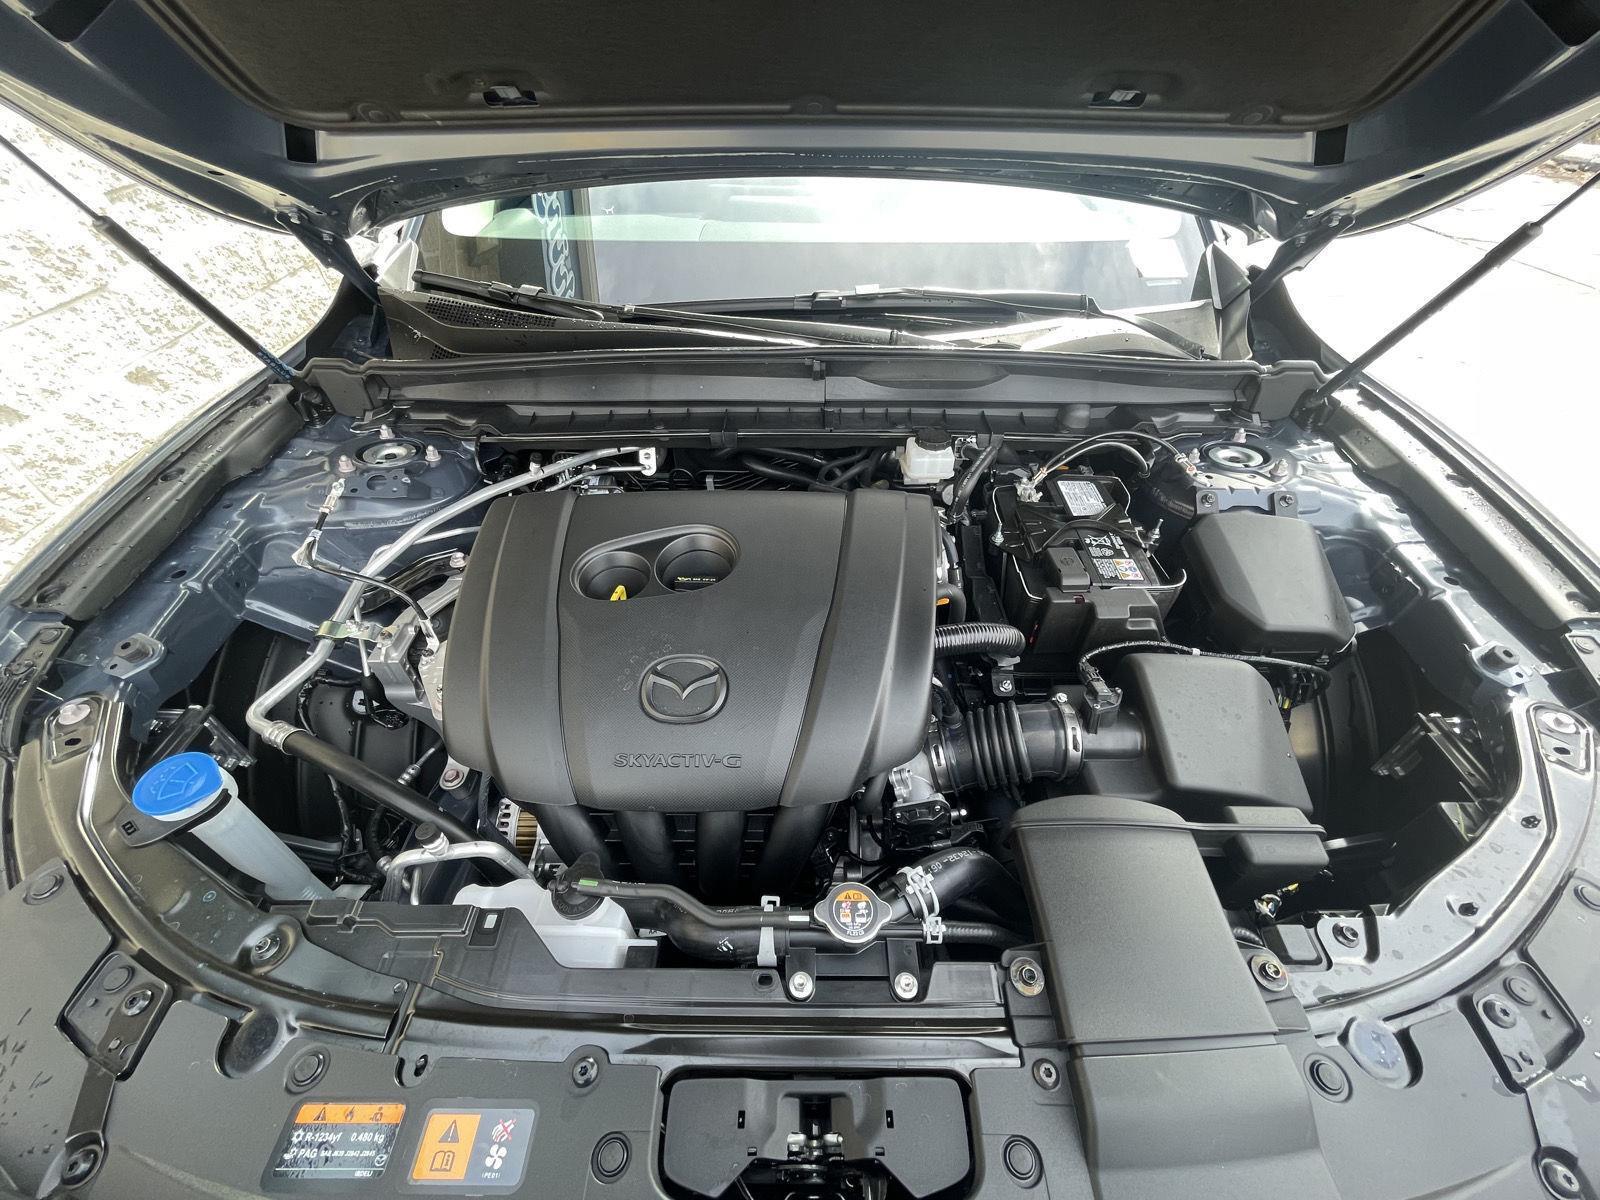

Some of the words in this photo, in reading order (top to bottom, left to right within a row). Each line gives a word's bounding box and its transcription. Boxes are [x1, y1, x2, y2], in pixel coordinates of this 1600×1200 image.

[613, 752, 742, 769] SKYACTIV-G
[304, 1132, 343, 1144] R-1234yf
[351, 1132, 372, 1142] 0.480
[373, 1132, 385, 1144] kg
[297, 1148, 318, 1158] PAG
